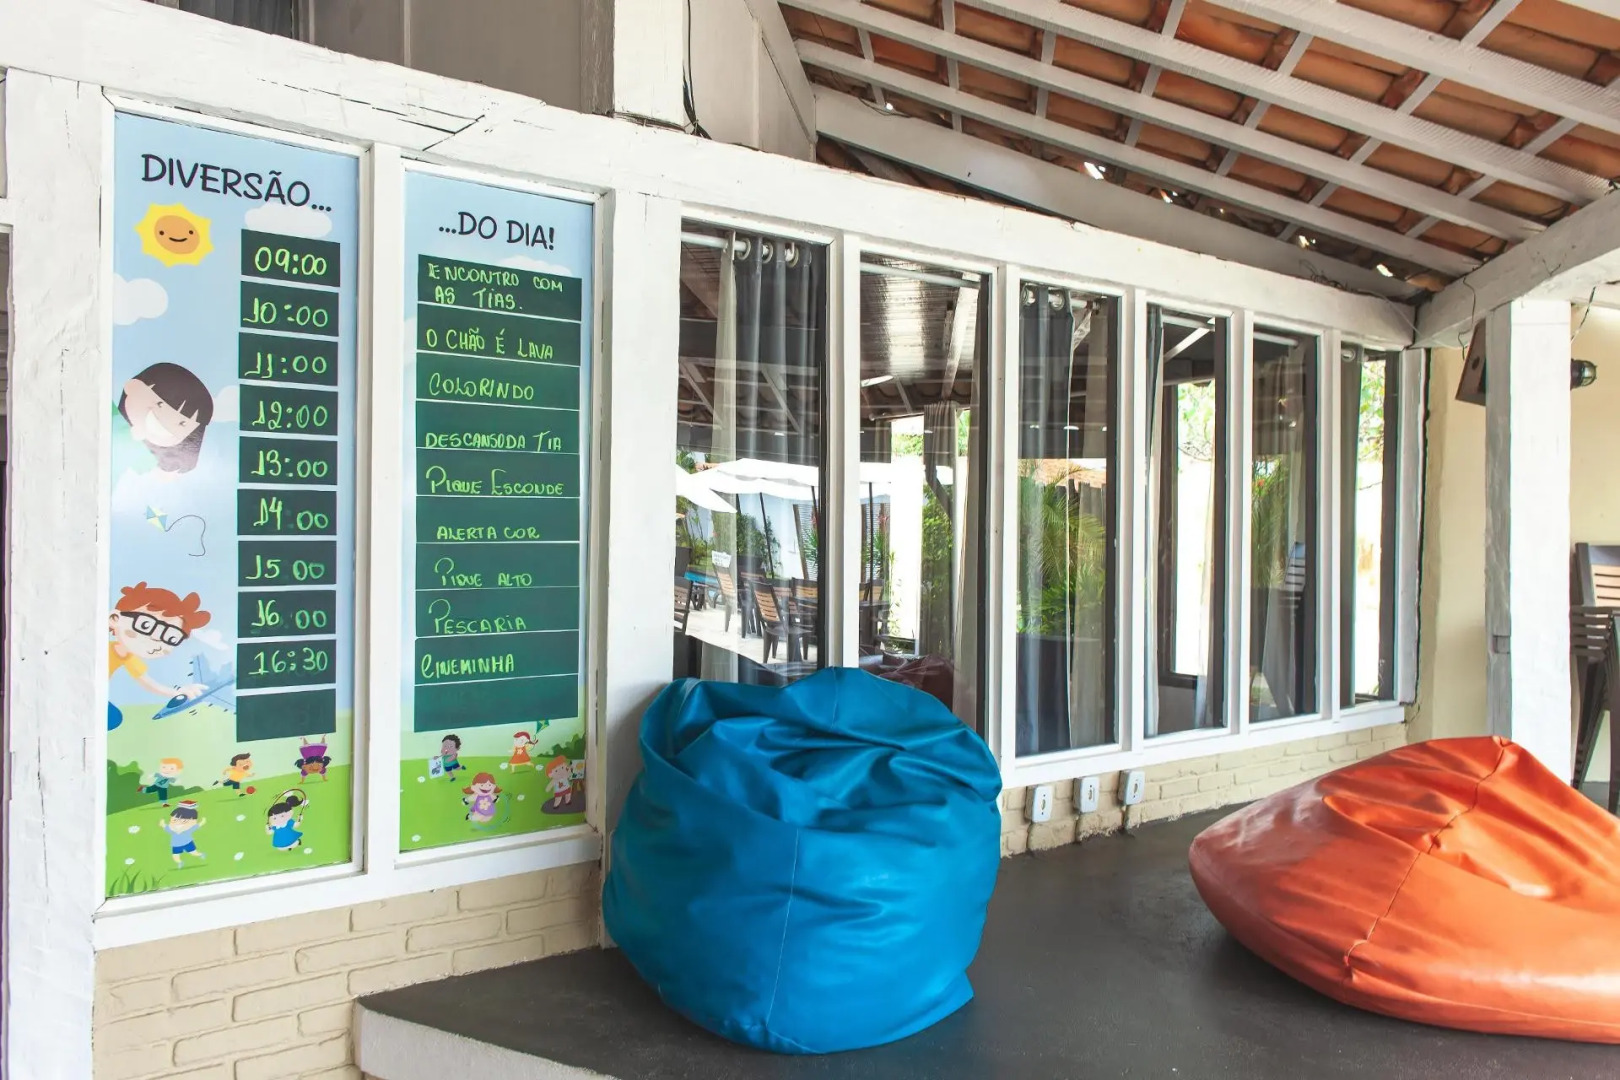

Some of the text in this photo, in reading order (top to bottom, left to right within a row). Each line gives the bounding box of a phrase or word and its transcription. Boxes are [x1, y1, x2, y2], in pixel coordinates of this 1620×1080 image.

[141, 153, 332, 212] DIVERSÃO...
[439, 211, 555, 251] ...DO DIA!
[255, 246, 328, 276] 09:00
[434, 285, 456, 305] AS
[533, 276, 563, 293] COM
[243, 297, 329, 328] 10:00
[426, 327, 554, 360] O CHÃO É LAVA
[244, 352, 327, 379] 11:00
[429, 372, 535, 401] COLORINDO
[252, 400, 329, 430] 12:00
[533, 430, 562, 453] TIA
[250, 449, 329, 478] 13:00
[436, 525, 541, 541] ALERTA COR
[497, 572, 533, 587] ALTO
[248, 647, 328, 675] 16:30
